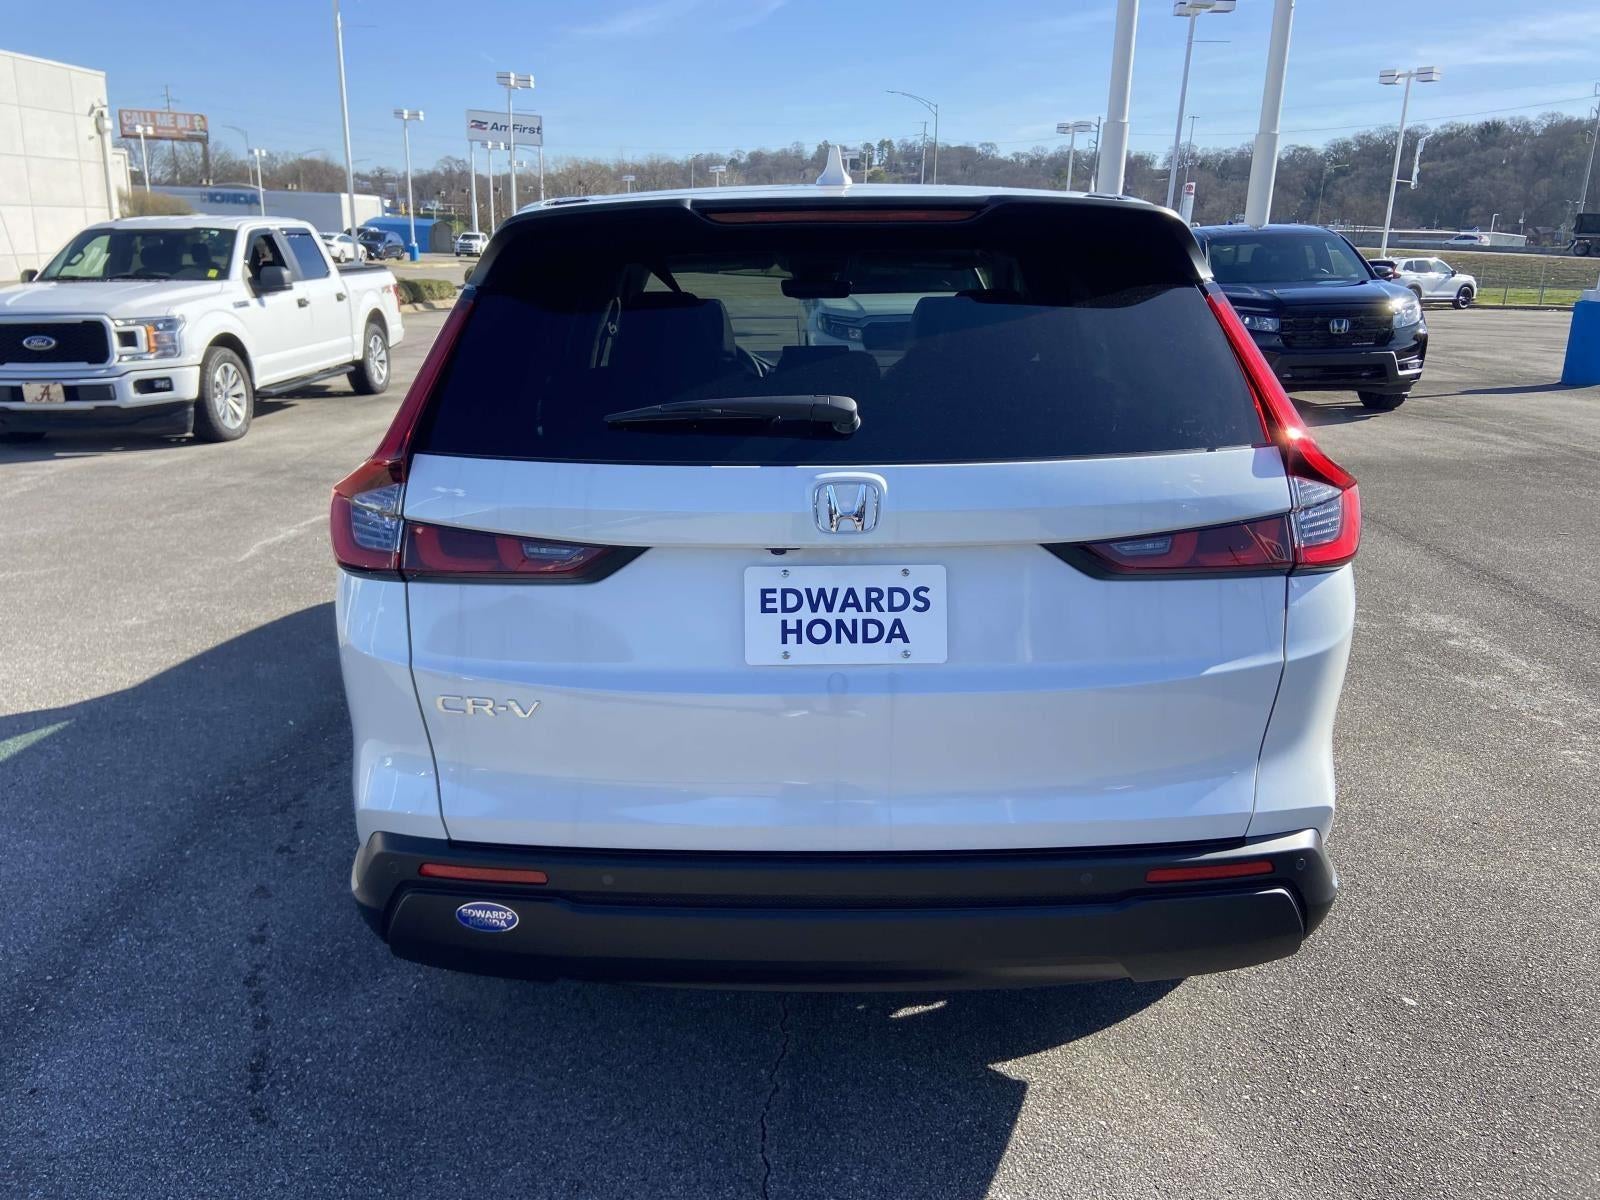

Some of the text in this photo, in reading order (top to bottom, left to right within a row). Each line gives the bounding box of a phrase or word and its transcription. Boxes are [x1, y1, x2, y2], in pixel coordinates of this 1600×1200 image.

[122, 111, 153, 125] CALL
[156, 114, 176, 127] ME
[490, 122, 541, 135] AmFirst
[760, 586, 931, 613] EDWARDS
[781, 618, 910, 645] HONDA
[436, 694, 541, 718] CR-V
[461, 908, 513, 920] EDWARDS
[469, 917, 507, 928] HONDA
